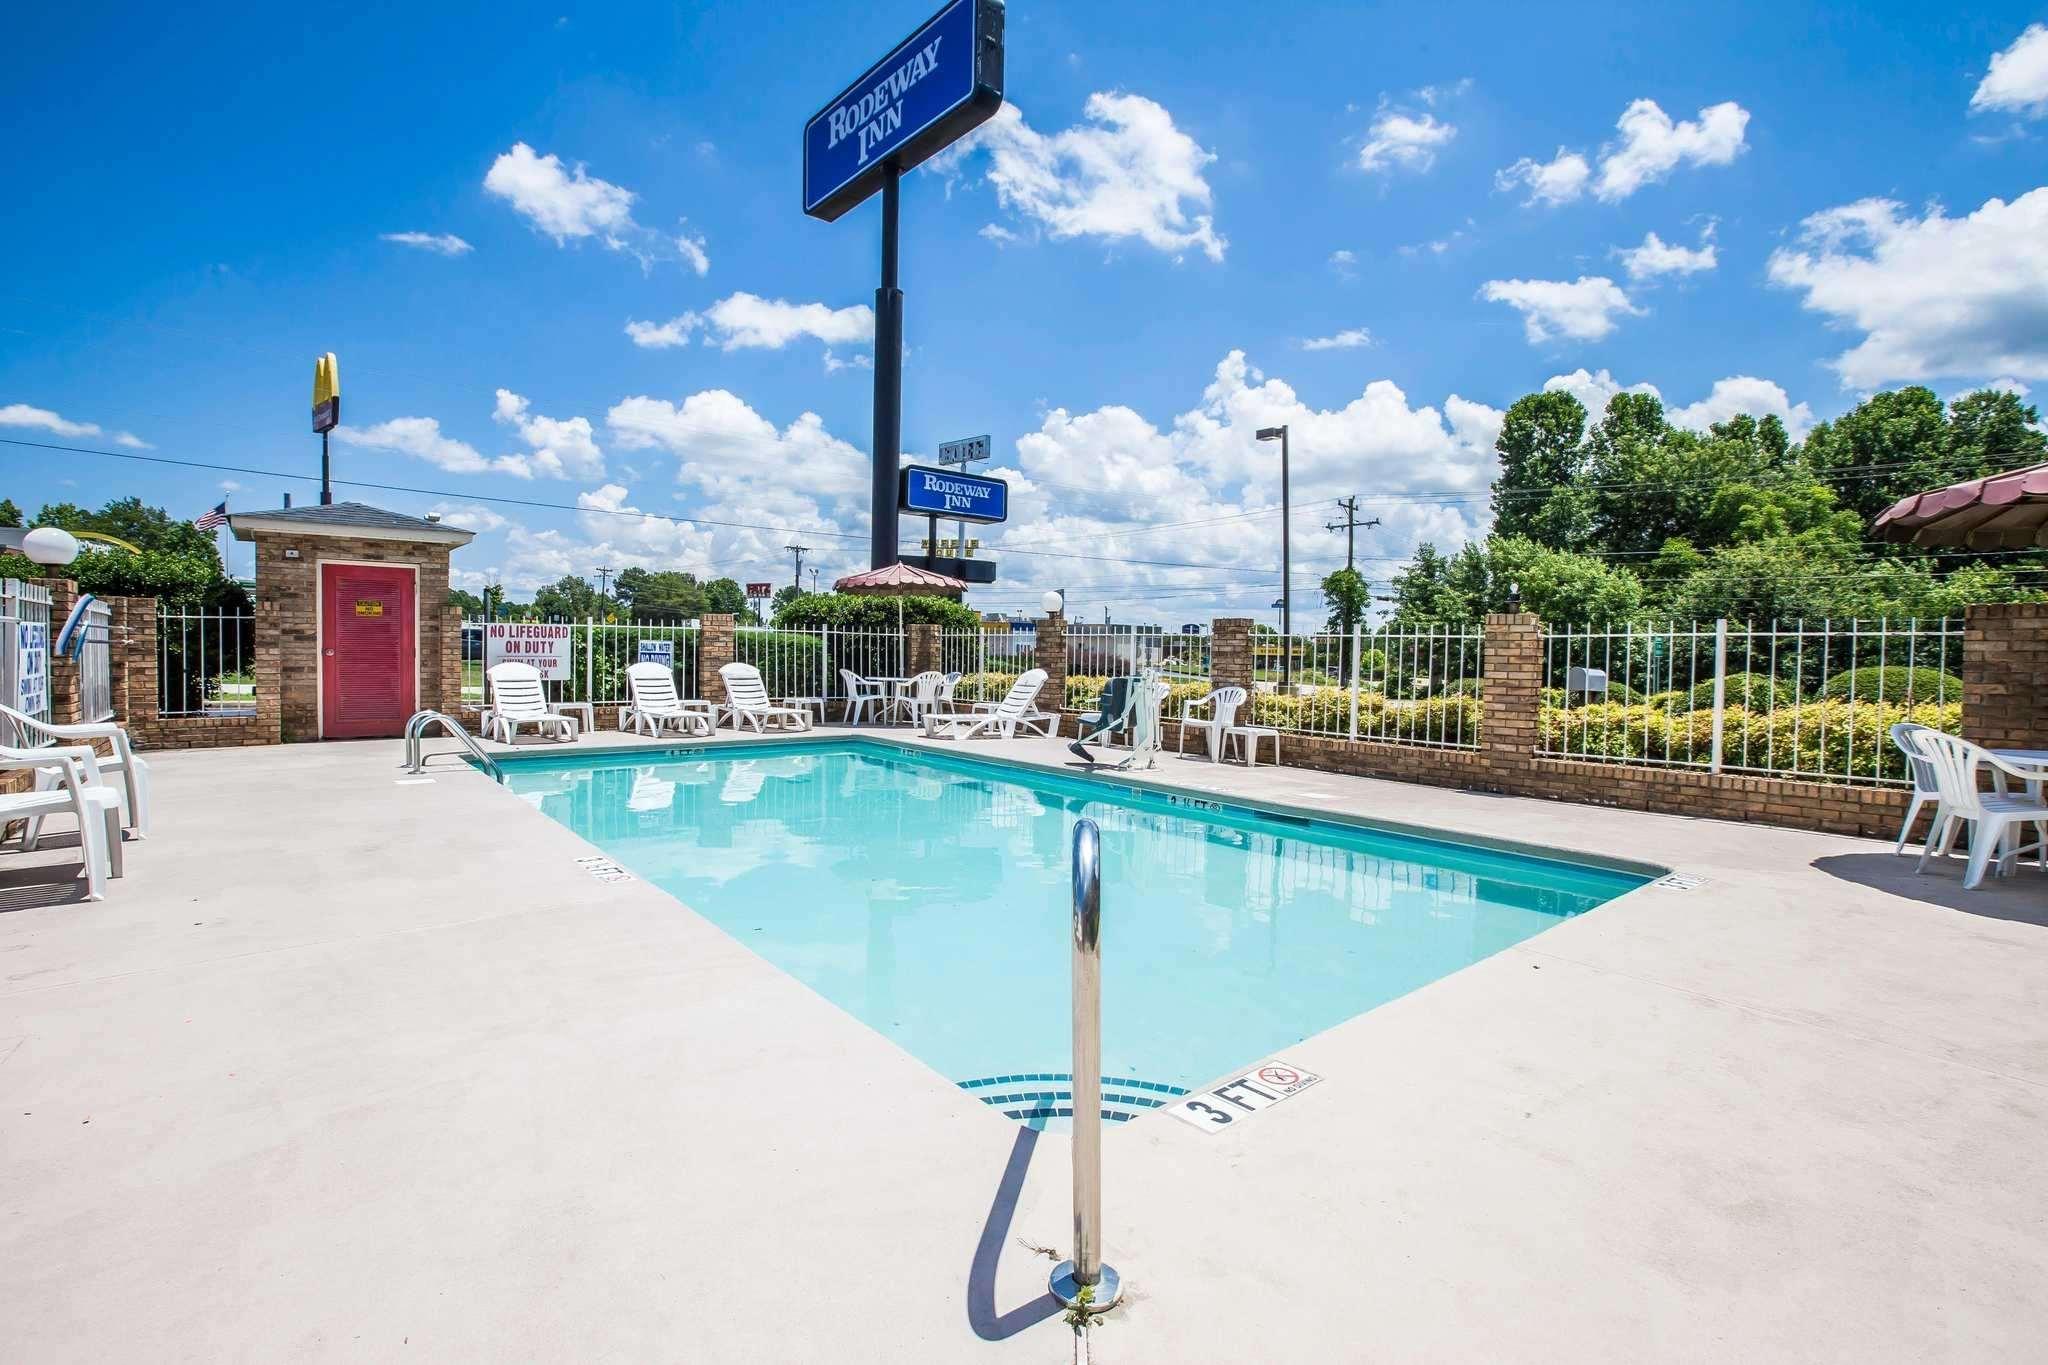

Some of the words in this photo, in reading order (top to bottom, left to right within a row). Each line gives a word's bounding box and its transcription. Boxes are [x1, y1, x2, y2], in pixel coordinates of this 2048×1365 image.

[828, 36, 942, 150] RODEWAY
[858, 99, 903, 166] INN
[923, 474, 992, 499] RODEWAY
[943, 494, 972, 509] INN
[490, 625, 505, 638] NO
[509, 625, 568, 639] LIFEGUARD
[506, 641, 520, 654] ON
[525, 641, 554, 654] DUTY
[538, 659, 558, 668] YOUR
[1186, 1101, 1233, 1124] 3
[1212, 1078, 1277, 1112] FT
